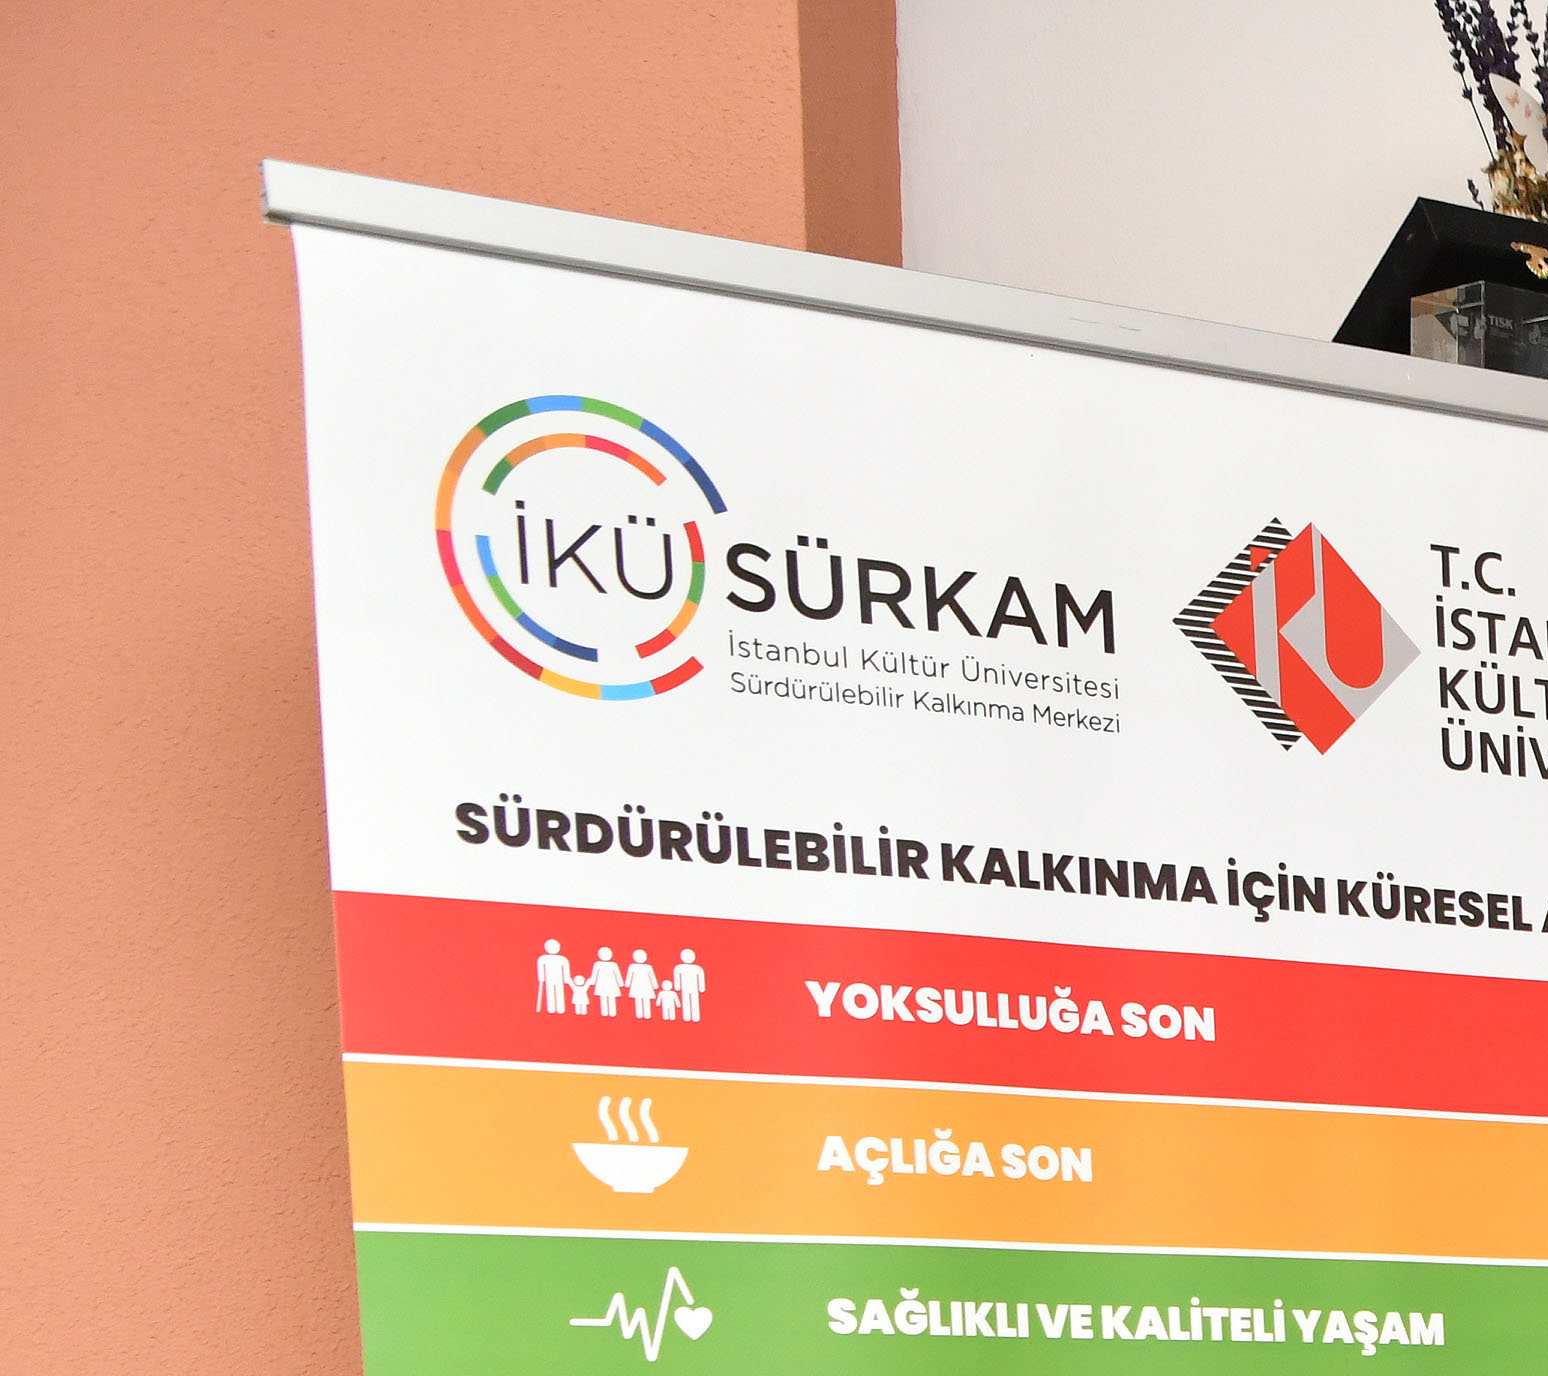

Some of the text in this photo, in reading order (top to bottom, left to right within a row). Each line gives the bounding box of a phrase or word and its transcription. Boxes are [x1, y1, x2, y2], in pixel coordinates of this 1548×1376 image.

[511, 499, 1116, 655] İKÜ SÜRKAM
[1430, 543, 1516, 597] T.C.
[729, 629, 1119, 700] İstanbul Kültür Üniversitesi
[731, 671, 1120, 734] Sürdürülebilir Kalkınma Merkezi
[455, 792, 930, 880] SÜRDÜRÜLEBİLİR
[940, 842, 1218, 905] KALKINMA
[1226, 857, 1327, 923] İÇİN
[1336, 871, 1533, 932] KÜRESEL
[804, 980, 1216, 1042] YOKSULLUĞA SON
[816, 1127, 1093, 1186] AÇLIĞA SON
[826, 1287, 1445, 1357] SAĞLIKLI VE KALİTELİ YAŞAM
